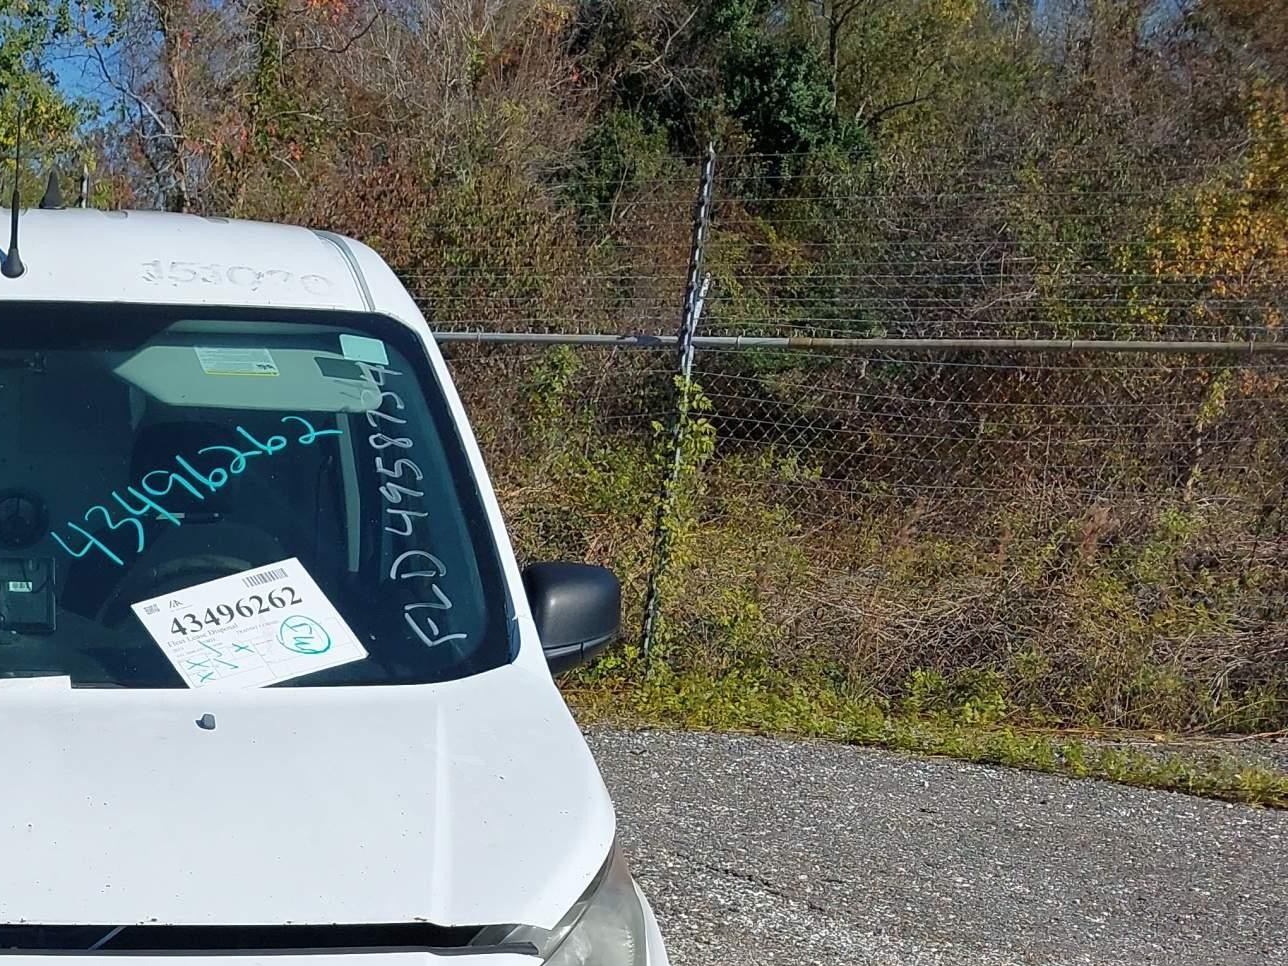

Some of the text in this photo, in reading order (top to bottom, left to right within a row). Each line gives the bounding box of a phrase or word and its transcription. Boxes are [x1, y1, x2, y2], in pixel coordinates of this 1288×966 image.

[51, 416, 344, 566] 43496262
[170, 585, 303, 637] 43496262
[390, 551, 468, 647] FLD
